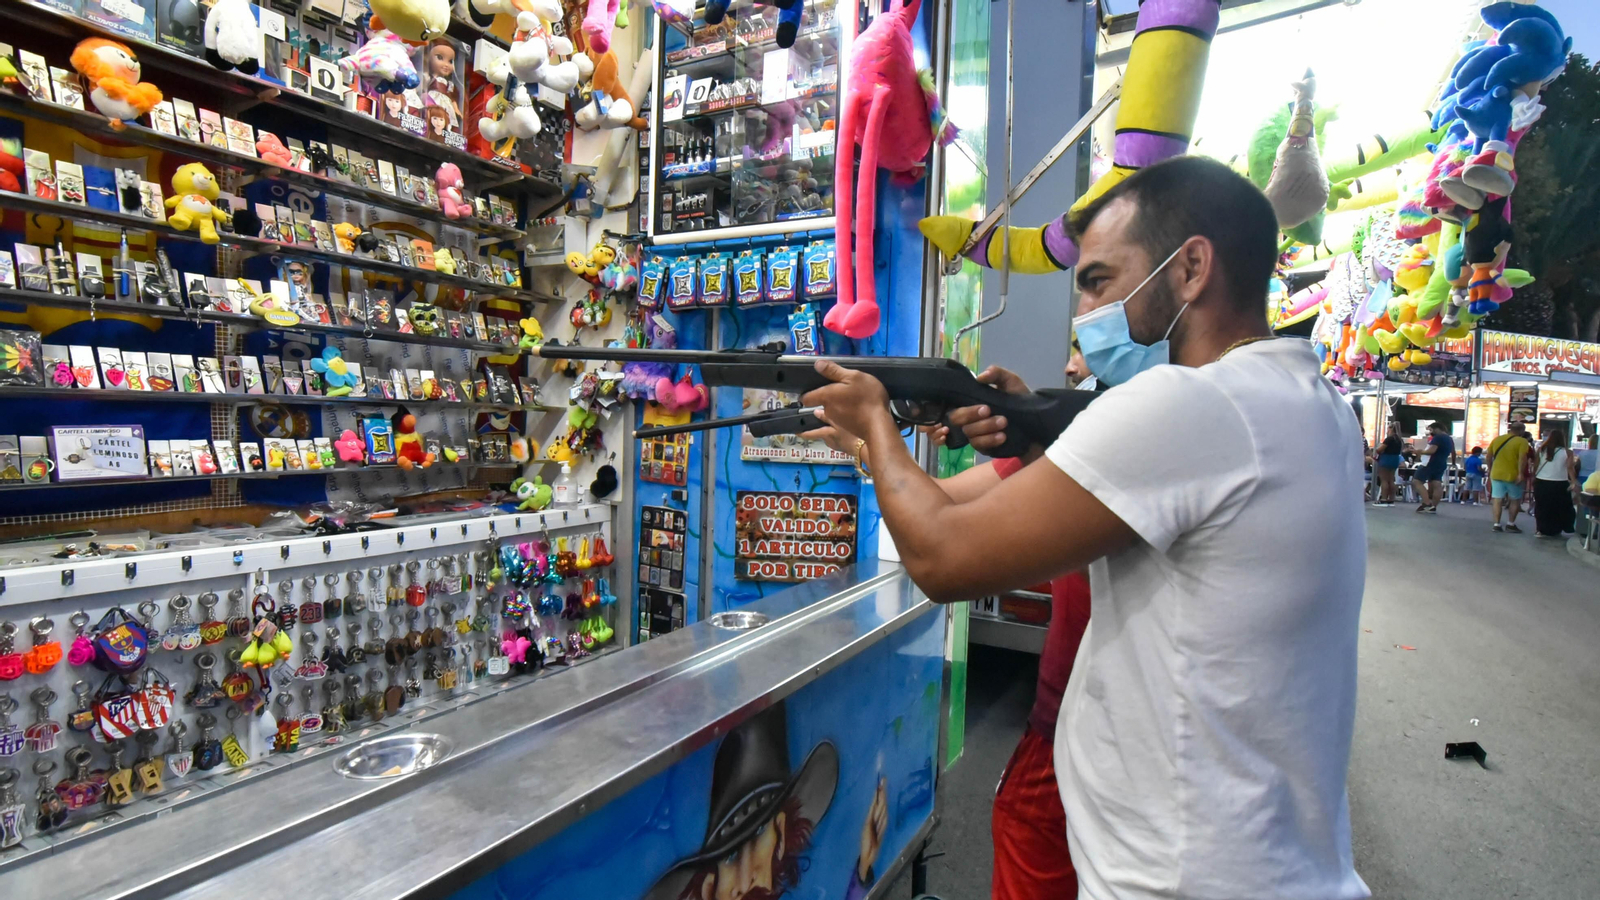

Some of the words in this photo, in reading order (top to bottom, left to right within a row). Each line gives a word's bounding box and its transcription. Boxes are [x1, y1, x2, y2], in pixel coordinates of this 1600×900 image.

[88, 14, 119, 29] ALTAVOZ
[119, 24, 152, 40] PORTATIL
[98, 438, 131, 447] CARTEL
[93, 449, 139, 459] LUMINOSO
[743, 446, 787, 457] Atracciones
[791, 448, 800, 457] La
[805, 449, 825, 458] Llave
[743, 495, 794, 511] SOLO
[800, 498, 850, 513] SERA
[761, 518, 831, 534] VALIDO
[740, 540, 749, 553] 1
[756, 541, 850, 557] ARTICULO
[748, 562, 787, 577] POR
[222, 736, 249, 767] VANS
